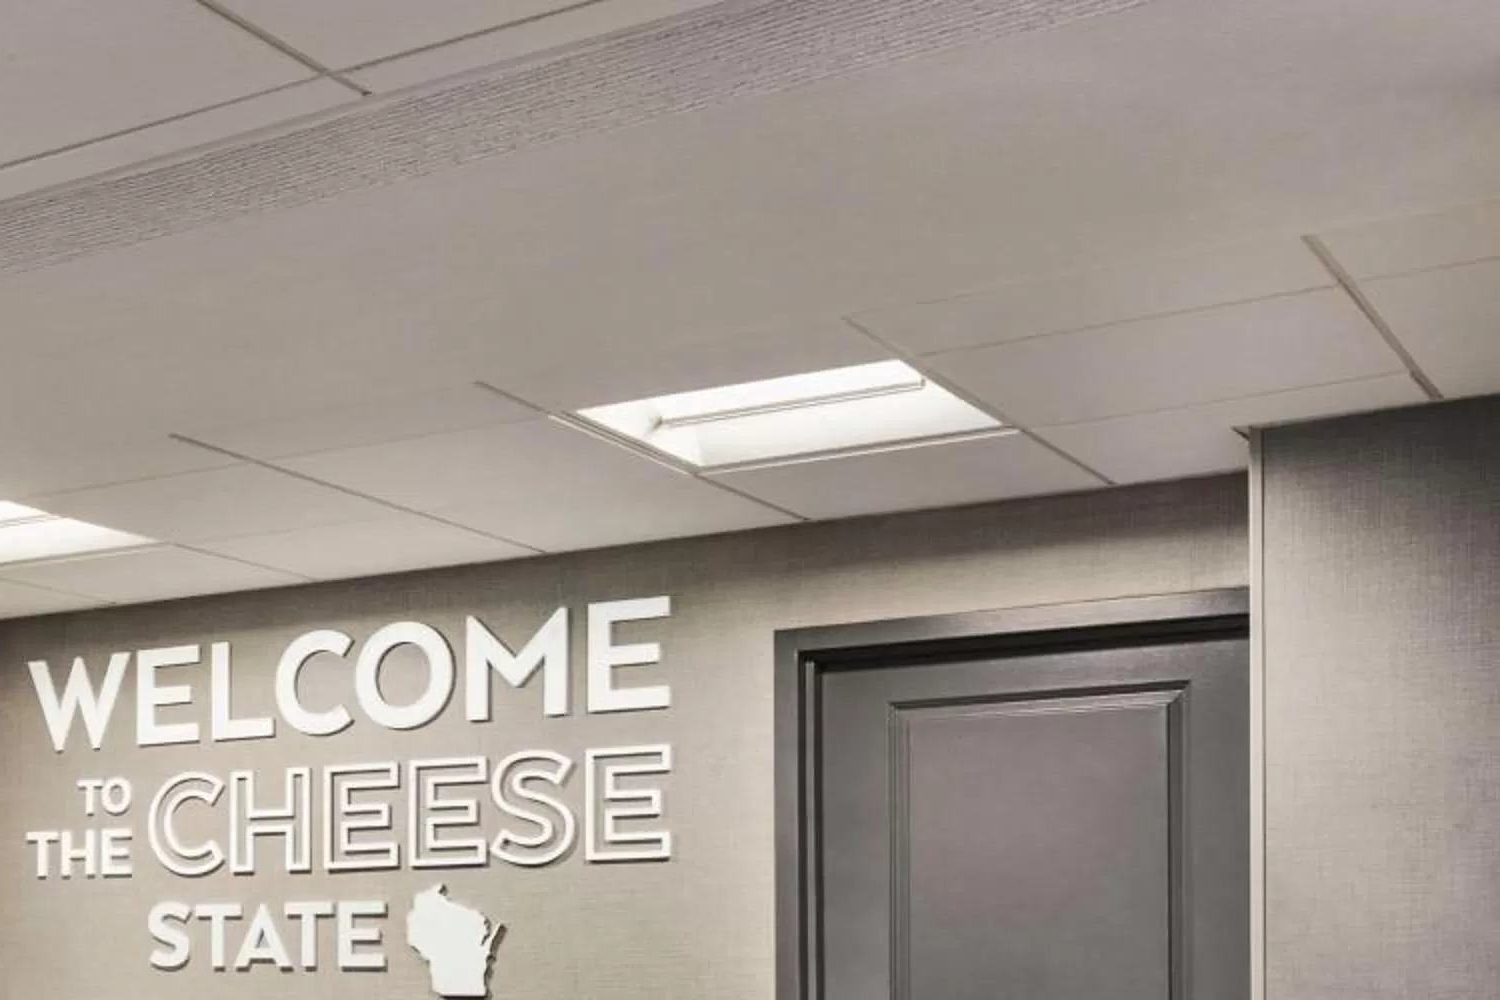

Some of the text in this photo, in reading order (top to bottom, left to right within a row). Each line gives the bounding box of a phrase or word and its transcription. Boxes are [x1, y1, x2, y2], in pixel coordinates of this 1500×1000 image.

[27, 596, 672, 751] WELCOME
[26, 744, 672, 878] THE CHEESE
[77, 777, 132, 815] TO
[148, 902, 388, 972] STATE
